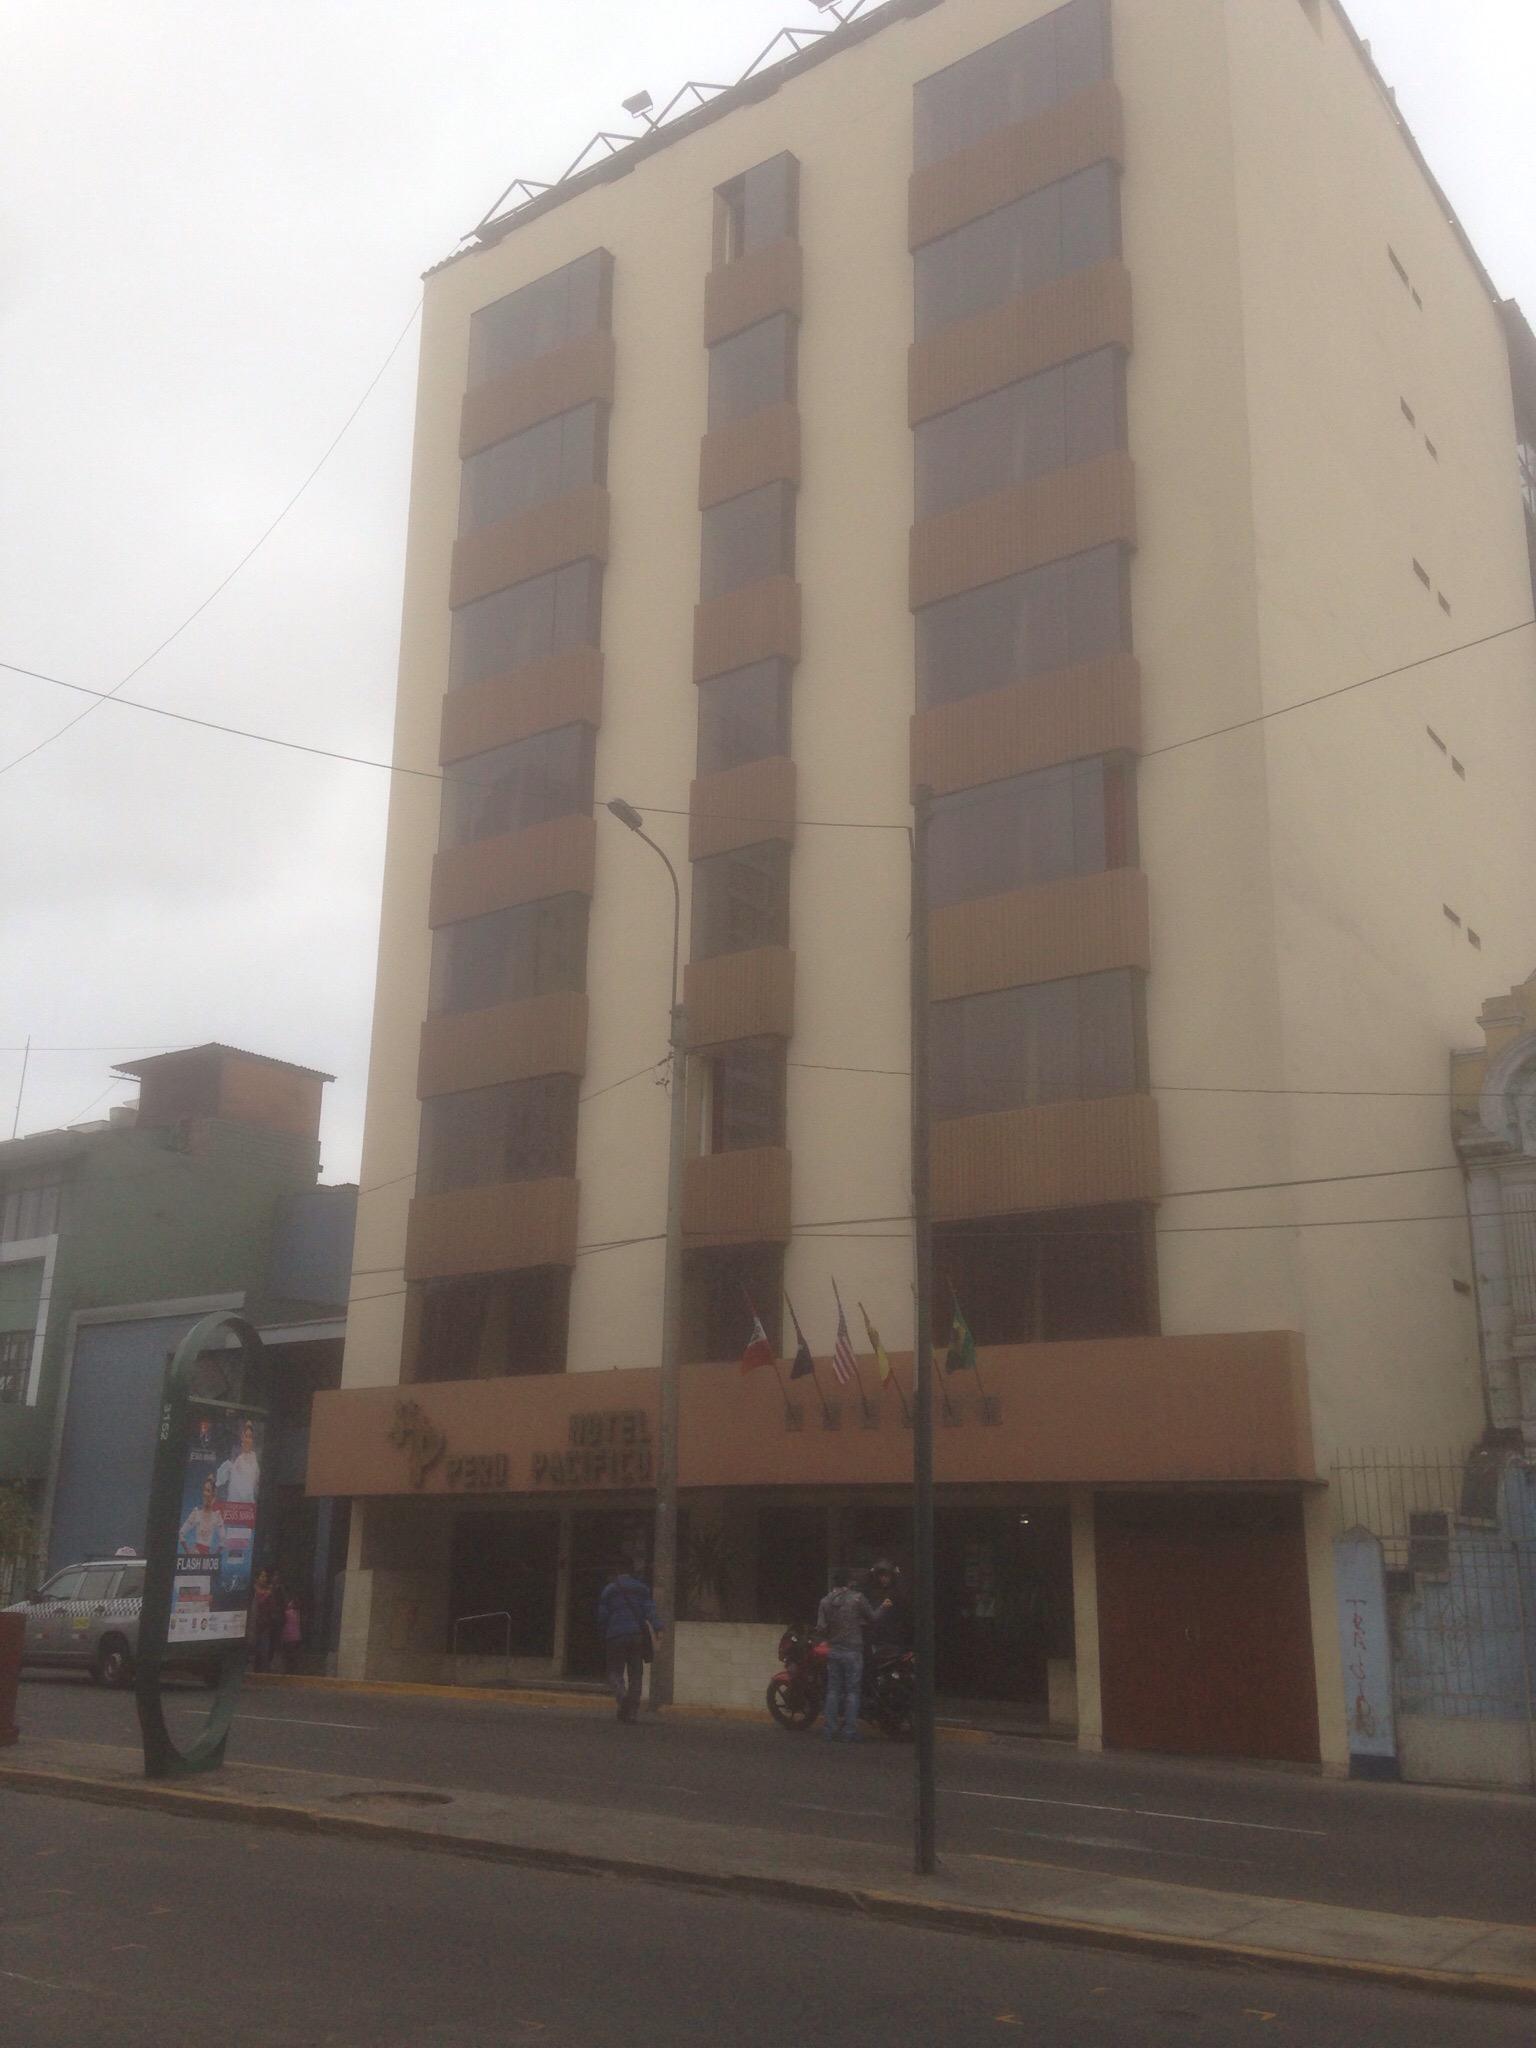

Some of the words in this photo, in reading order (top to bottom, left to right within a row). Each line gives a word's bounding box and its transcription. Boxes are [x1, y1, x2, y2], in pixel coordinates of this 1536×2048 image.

[569, 1410, 652, 1447] HOTEL
[446, 1455, 509, 1490] PERU
[531, 1448, 652, 1486] PACIFICO
[176, 1557, 201, 1571] FLASH
[201, 1557, 220, 1571] MOB
